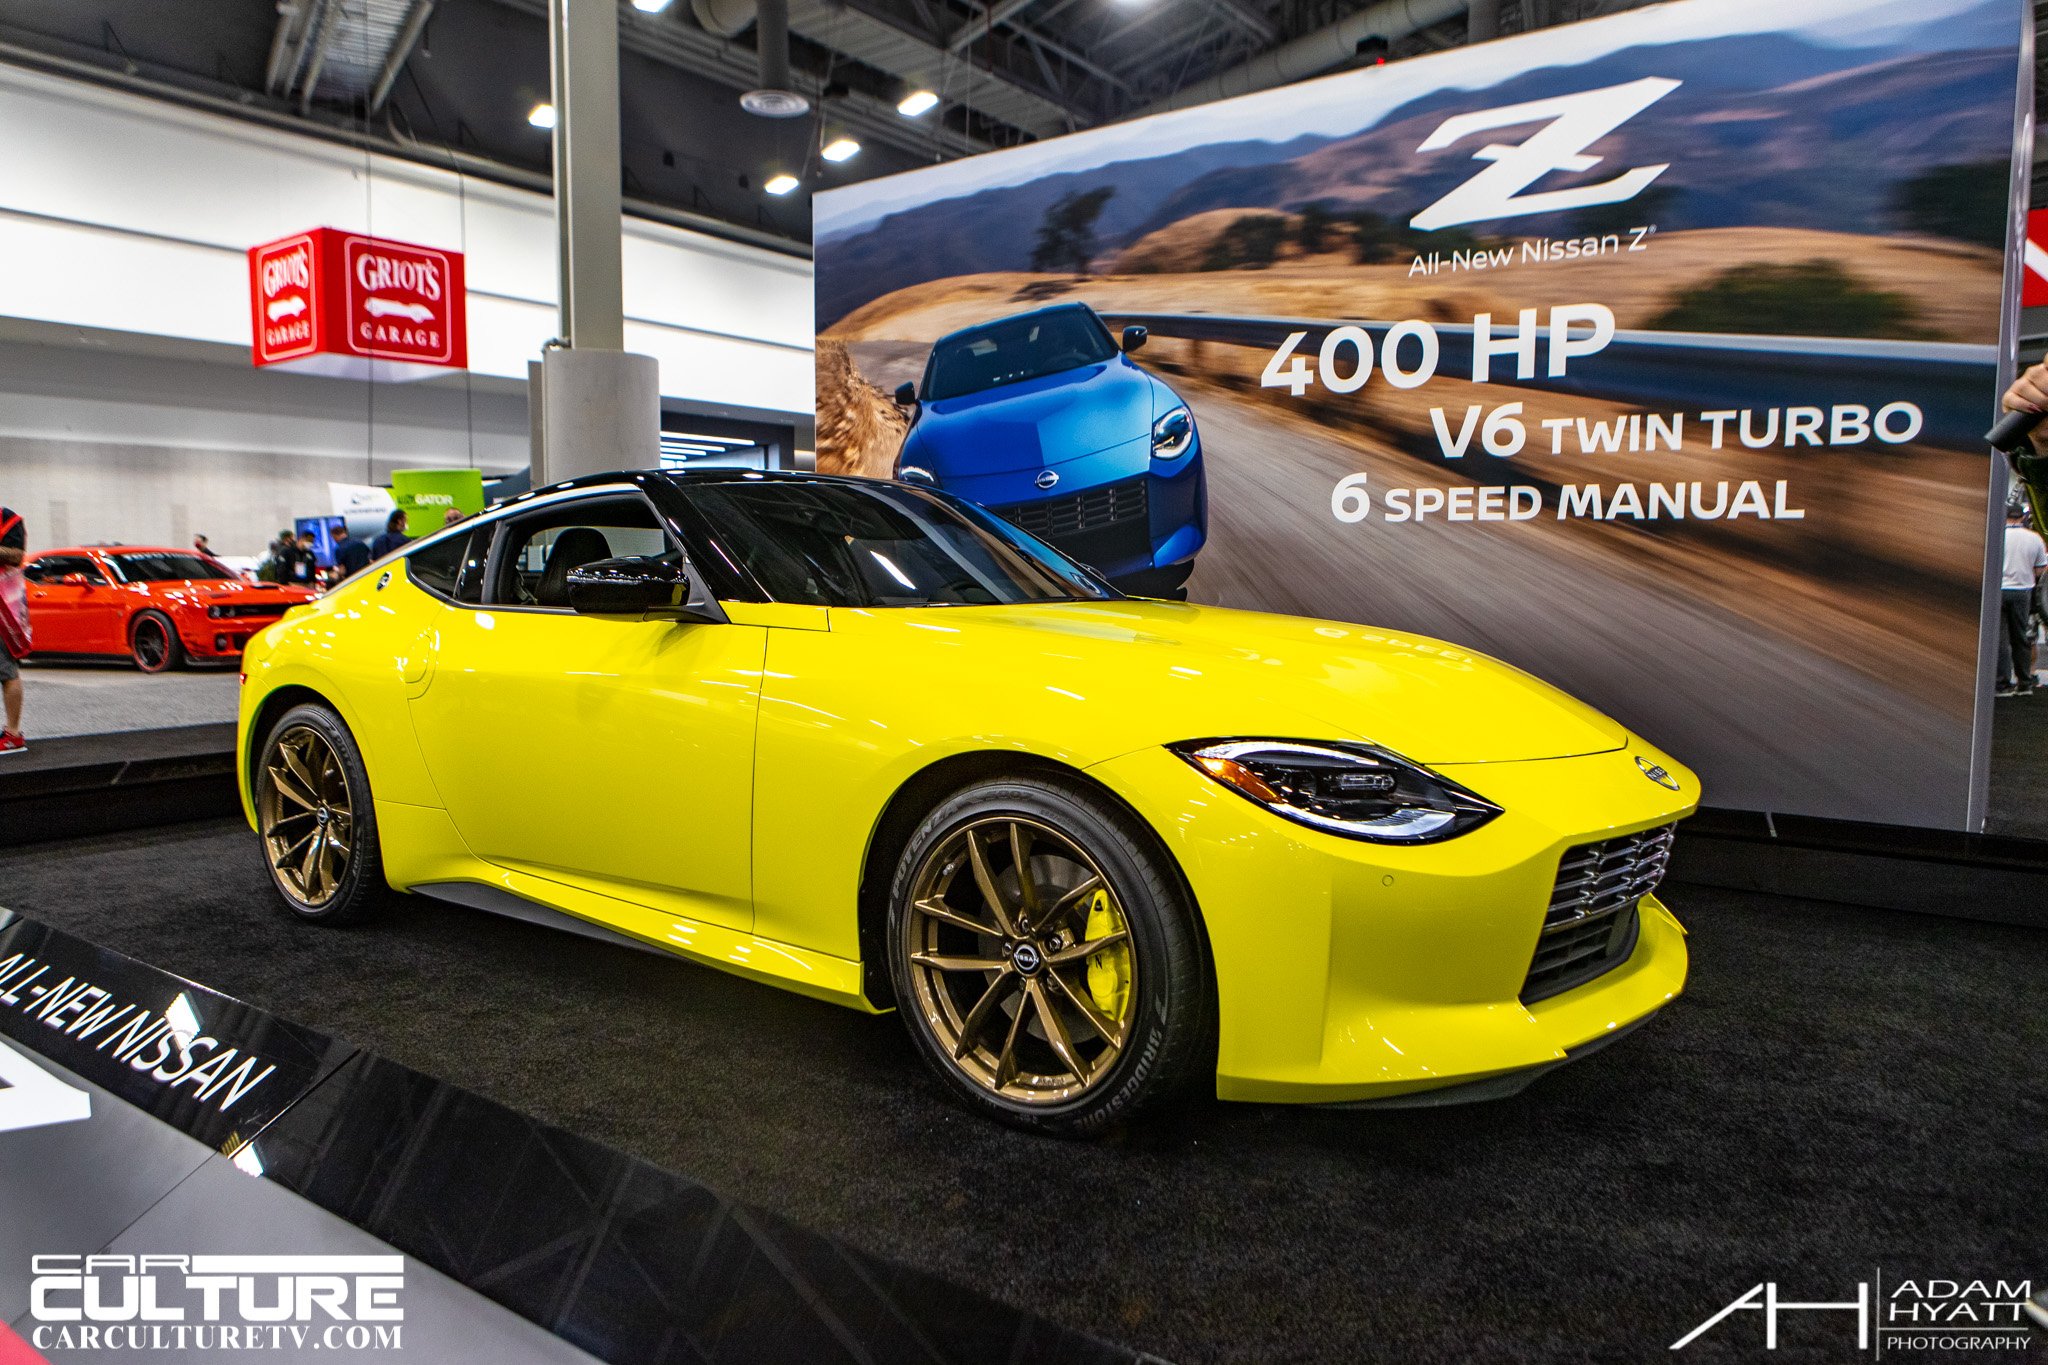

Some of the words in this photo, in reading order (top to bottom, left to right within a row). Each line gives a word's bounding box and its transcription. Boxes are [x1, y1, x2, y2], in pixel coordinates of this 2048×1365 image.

[1409, 76, 1684, 231] Z
[356, 253, 441, 301] GRIOT'S
[1408, 246, 1514, 278] All-New
[1521, 233, 1619, 264] Nissan
[265, 320, 310, 347] GARAGE
[359, 322, 440, 348] GARAGE
[1261, 319, 1439, 396] 400
[1472, 303, 1615, 383] HP
[1430, 402, 1526, 458] V6
[1541, 412, 1683, 455] TWIN
[1700, 401, 1923, 450] TURBO
[1331, 472, 1370, 523] 6
[1385, 486, 1543, 522] SPEED
[1557, 480, 1805, 521] MANUAL
[96, 1010, 277, 1112] NISSAN
